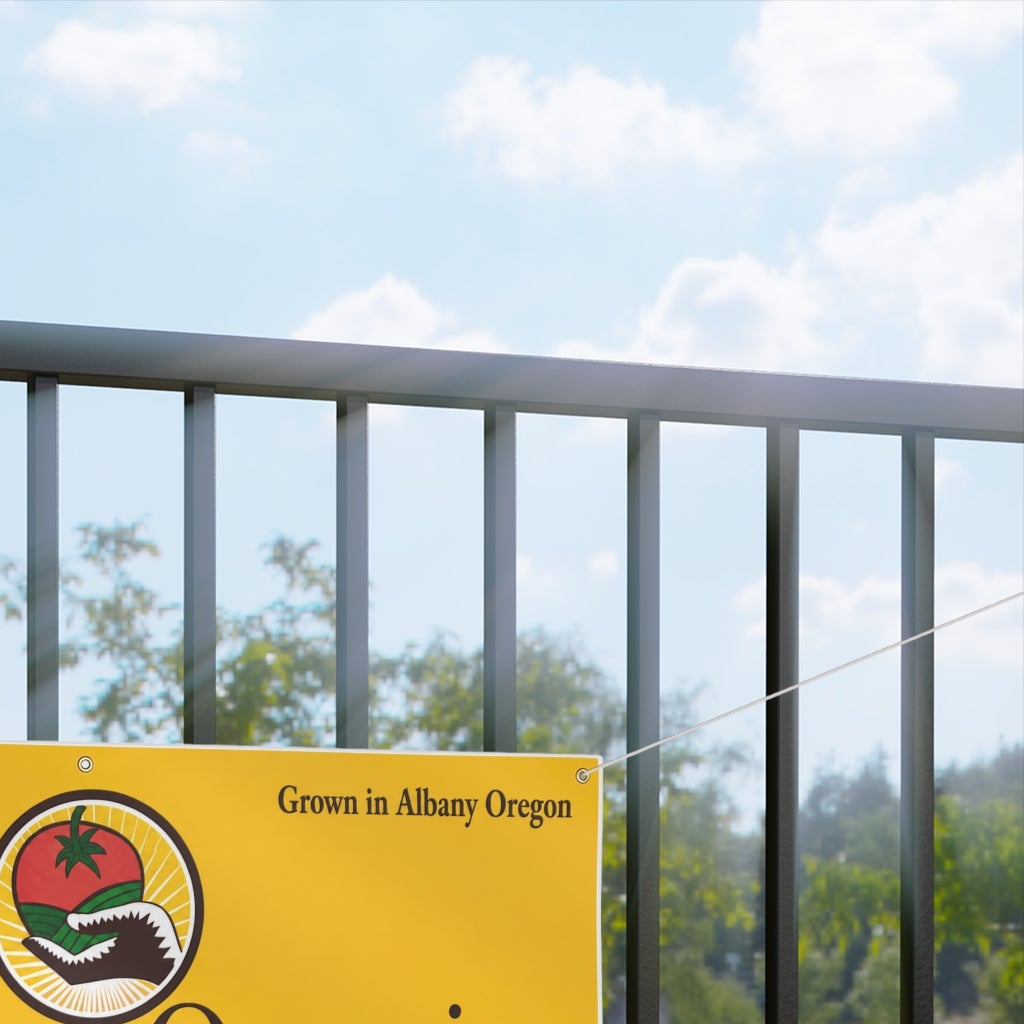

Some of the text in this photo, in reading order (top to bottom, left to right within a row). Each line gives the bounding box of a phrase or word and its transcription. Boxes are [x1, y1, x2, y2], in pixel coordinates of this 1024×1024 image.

[277, 784, 573, 829] Grown in Albany Oregon
